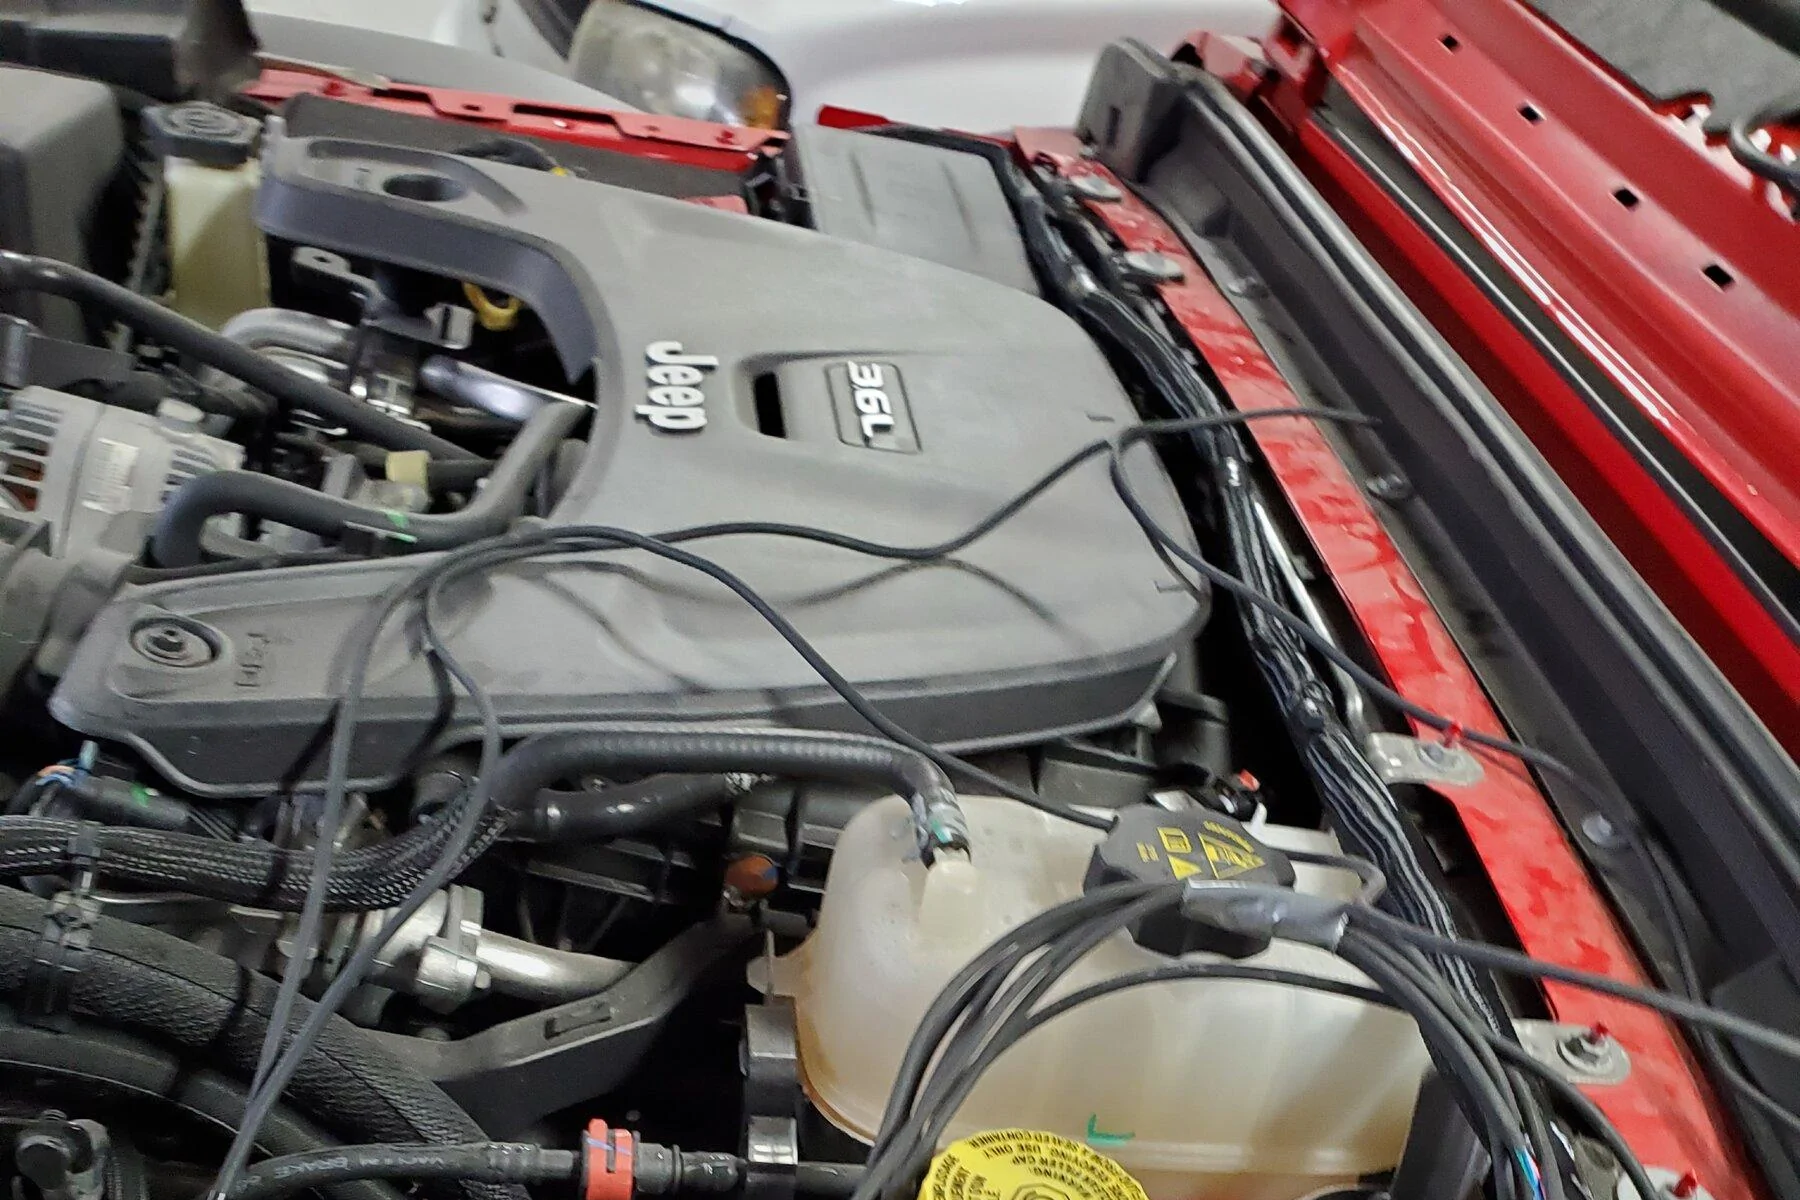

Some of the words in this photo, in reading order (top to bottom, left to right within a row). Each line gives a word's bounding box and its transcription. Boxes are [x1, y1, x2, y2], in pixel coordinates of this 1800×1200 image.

[634, 340, 719, 433] Jeep
[968, 1131, 1032, 1150] CONTAINER
[1016, 1142, 1042, 1154] USE
[982, 1144, 1014, 1160] ONLY
[1010, 1154, 1036, 1166] CAP
